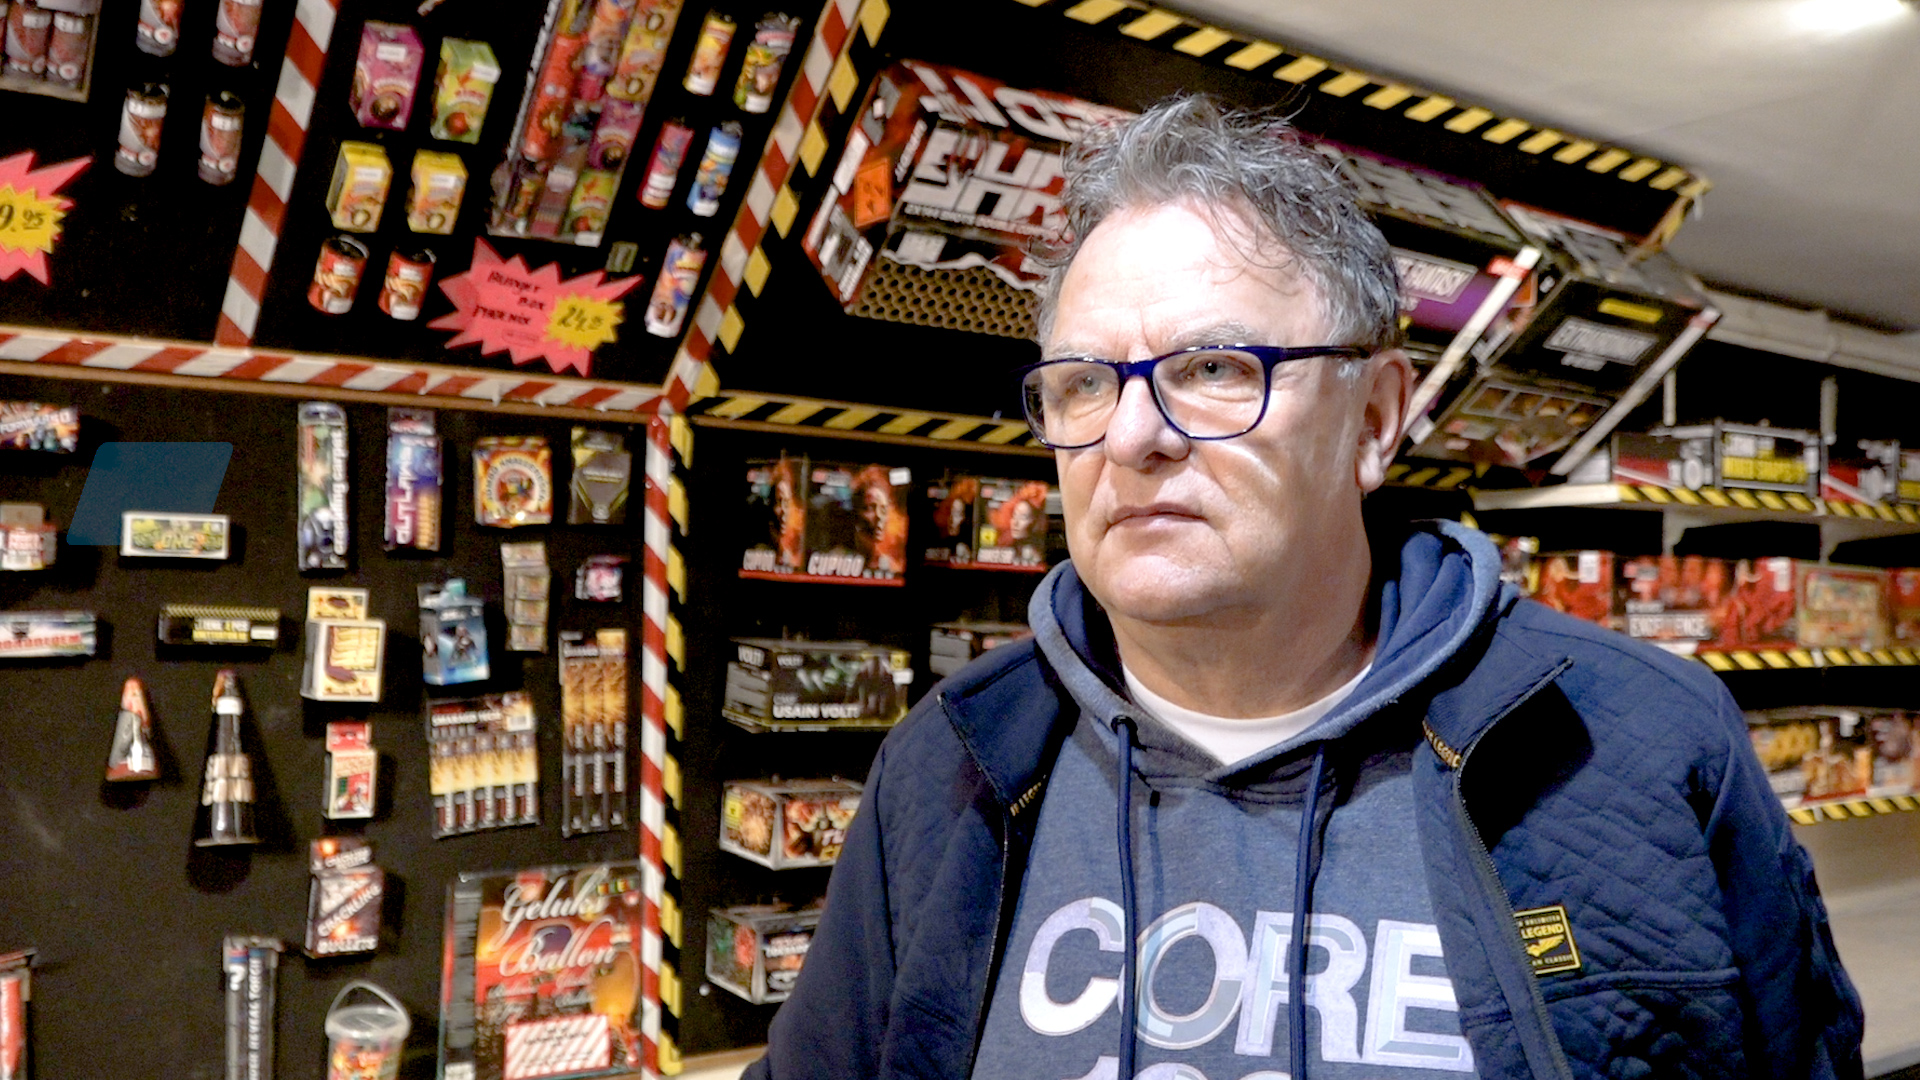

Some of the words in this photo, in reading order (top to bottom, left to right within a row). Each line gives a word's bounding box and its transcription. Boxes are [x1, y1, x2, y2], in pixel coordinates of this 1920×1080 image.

[807, 551, 866, 578] CUPIDO
[772, 702, 820, 718] USAIN
[1521, 923, 1565, 939] LEGEND
[1019, 896, 1475, 1073] CORE
